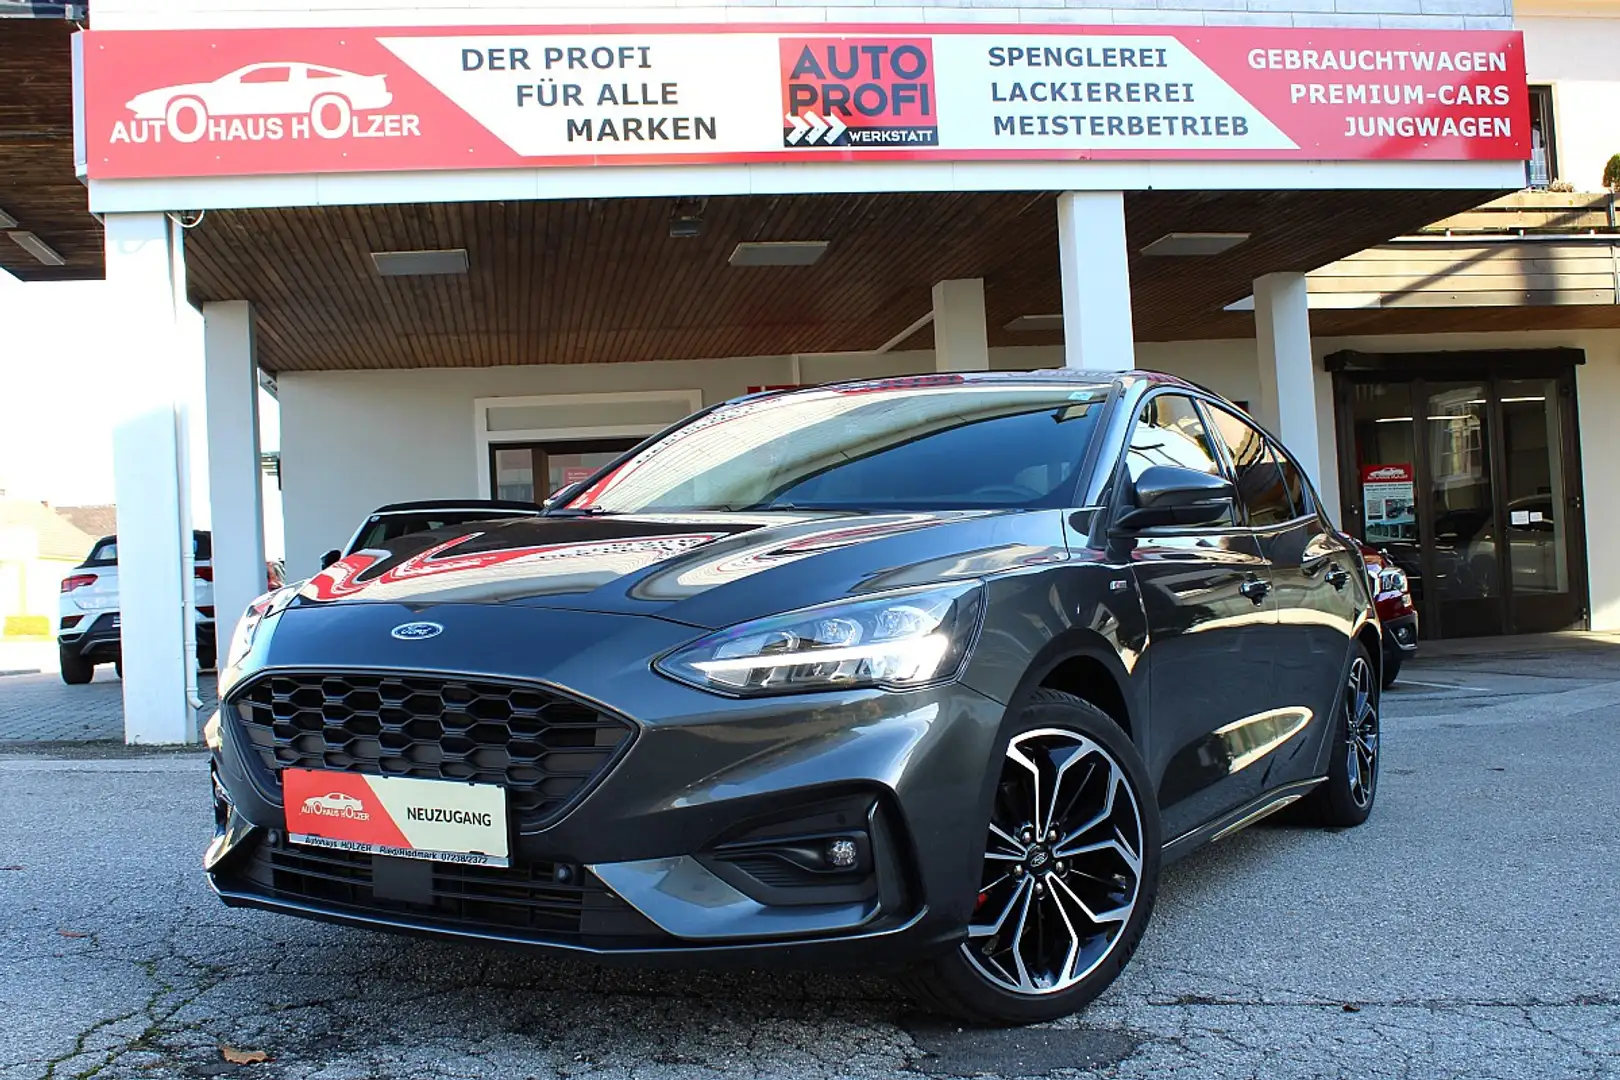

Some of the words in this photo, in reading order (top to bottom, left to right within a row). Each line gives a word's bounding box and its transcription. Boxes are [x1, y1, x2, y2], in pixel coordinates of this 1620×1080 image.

[461, 47, 531, 71] DER
[544, 46, 652, 70] PROFI
[789, 44, 928, 81] AUTO
[988, 46, 1167, 69] SPENGLEREI
[1247, 48, 1507, 72] GEBRAUCHTWAGEN
[516, 78, 585, 107] FÜR
[597, 82, 679, 106] ALLE
[789, 83, 930, 117] PROFI
[991, 81, 1195, 103] LACKIEREREI
[1290, 83, 1510, 106] PREMIUM-CARS
[110, 96, 284, 144] AUTOHAUS
[292, 94, 421, 140] HOLZER
[566, 115, 717, 142] MARKEN
[993, 114, 1249, 137] MEISTERBETRIEB
[1344, 116, 1512, 138] JUNGWAGEN
[849, 129, 933, 143] WERKSTATT
[406, 806, 492, 827] NEUZUGANG
[340, 840, 373, 852] HOLZER
